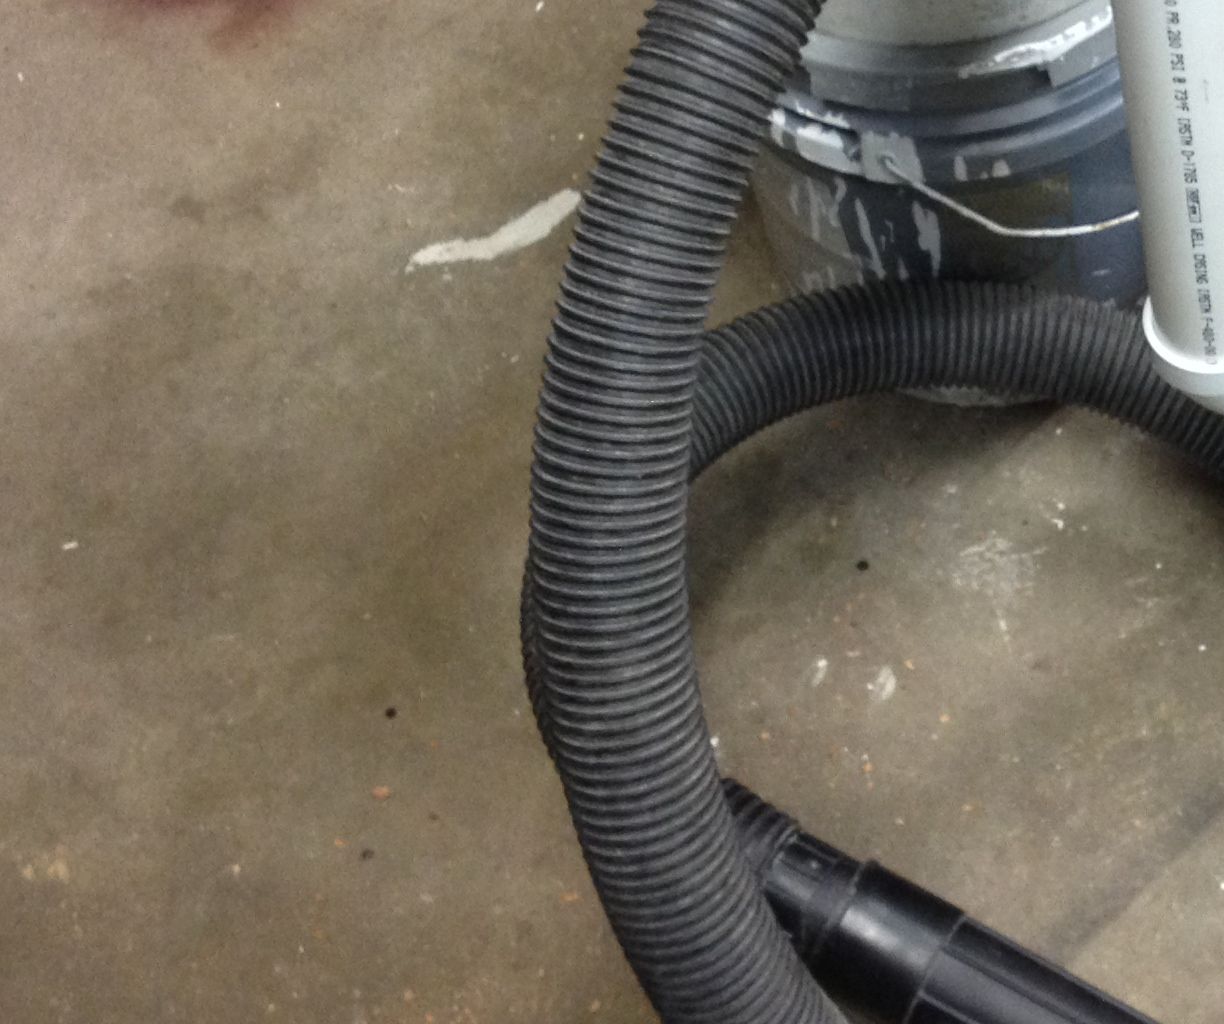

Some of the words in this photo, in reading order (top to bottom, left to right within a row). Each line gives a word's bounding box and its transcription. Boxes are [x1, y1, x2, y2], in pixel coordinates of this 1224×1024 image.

[1170, 52, 1186, 72] PSI
[1190, 227, 1205, 248] WELL
[1193, 253, 1209, 285] CASING
